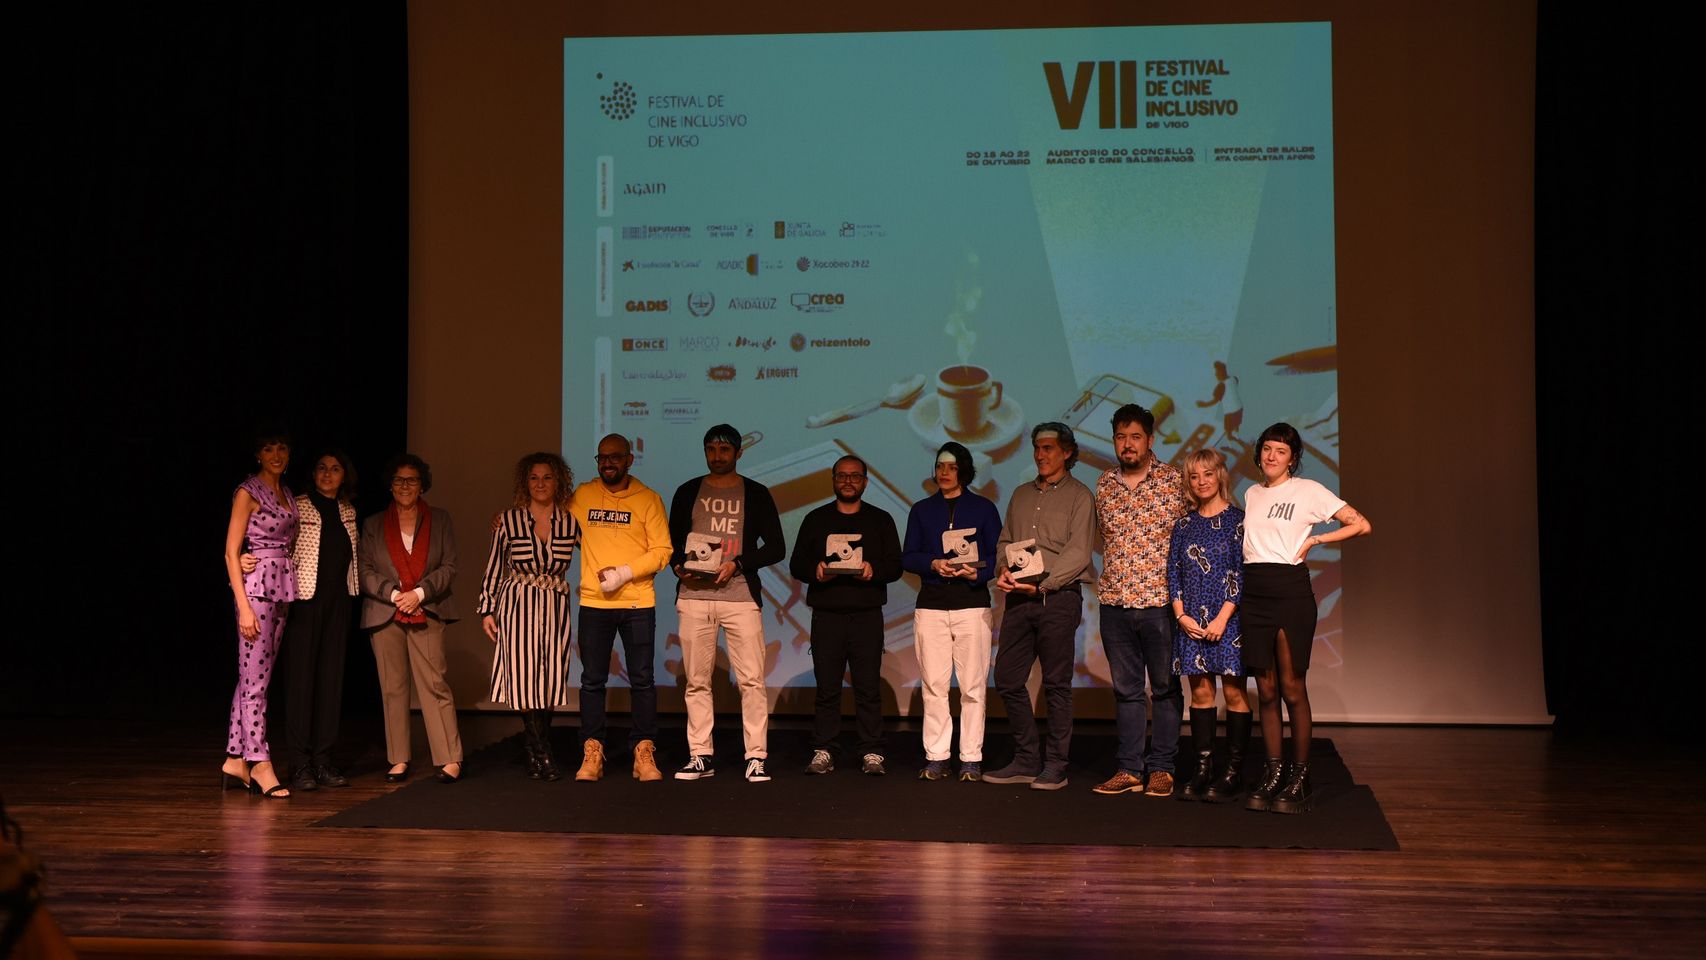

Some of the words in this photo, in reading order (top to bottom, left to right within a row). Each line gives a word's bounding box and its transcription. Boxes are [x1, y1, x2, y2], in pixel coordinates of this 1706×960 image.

[1145, 60, 1229, 77] FESTIVAL
[1145, 80, 1168, 97] DE
[1172, 79, 1212, 96] CINE
[1042, 60, 1137, 130] VII
[648, 96, 704, 109] FESTIVAL
[708, 95, 724, 108] DE
[1145, 99, 1238, 117] INCLUSIVO
[648, 116, 678, 128] CINE
[681, 114, 748, 128] INCLUSIVO
[1146, 121, 1160, 129] DE
[1164, 120, 1189, 128] VIGO
[648, 135, 664, 148] DE
[668, 135, 699, 148] VIGO
[1046, 157, 1086, 165] MARCO
[810, 292, 844, 305] crea
[625, 300, 668, 312] GADIS
[635, 340, 664, 349] ONCE
[680, 336, 719, 348] MARCO
[810, 337, 870, 348] reizentolo
[700, 496, 740, 514] YOU
[590, 510, 606, 520] PEPE
[606, 512, 629, 522] JEANS
[710, 517, 738, 534] ME
